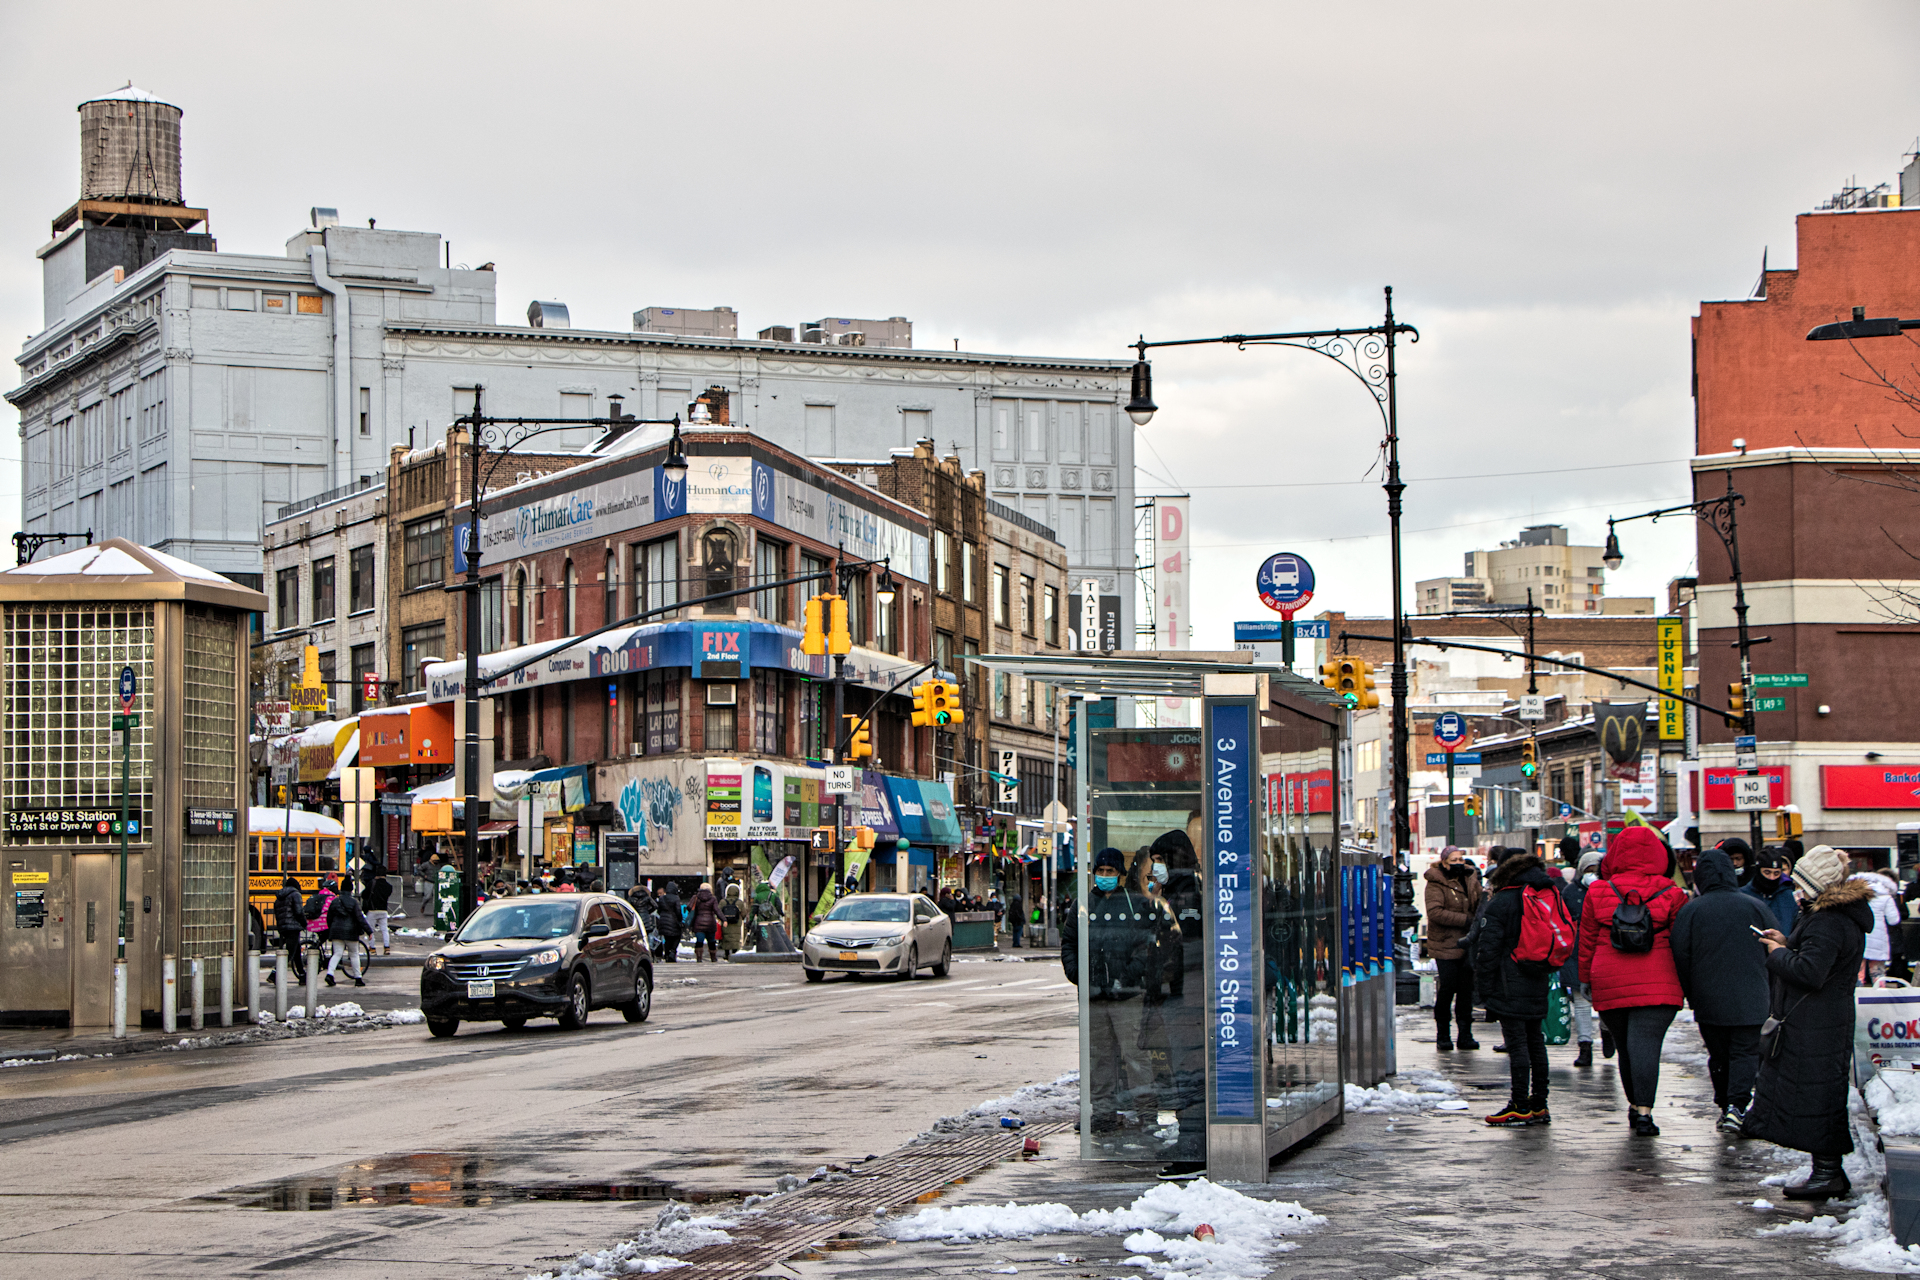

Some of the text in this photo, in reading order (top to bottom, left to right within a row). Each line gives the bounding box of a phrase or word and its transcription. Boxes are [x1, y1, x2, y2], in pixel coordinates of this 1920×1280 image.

[687, 484, 752, 495] HumanCare
[531, 496, 593, 535] HumanCare
[838, 504, 877, 546] HumanCare
[1263, 594, 1310, 611] NO STANDING
[1085, 583, 1098, 650] TATTOO
[1237, 623, 1278, 632] Williamsbridge
[1296, 624, 1326, 638] Bx41
[702, 632, 740, 652] FIX
[706, 652, 740, 660] 2nd Floor
[548, 658, 585, 673] Computer Repair
[368, 678, 376, 698] TAX
[443, 678, 460, 697] Phone
[292, 688, 326, 706] FABRIC
[257, 701, 290, 714] INCOME
[1756, 700, 1761, 710] E
[1763, 699, 1776, 710] 149
[1521, 708, 1544, 716] TURNS
[417, 749, 439, 757] NAILS
[1173, 756, 1180, 765] B
[1427, 754, 1446, 764] Bx41
[833, 770, 845, 778] NO
[1708, 774, 1731, 785] Bank
[1884, 772, 1910, 783] Bank
[1744, 781, 1759, 791] NO
[1526, 796, 1536, 807] NO
[1737, 795, 1768, 804] TURNS
[10, 811, 117, 823] 3 Av-149 St Station
[1522, 813, 1541, 823] TURNS
[10, 823, 21, 831] To
[22, 823, 37, 831] 241
[39, 822, 49, 831] St
[60, 822, 80, 832] Dyre
[81, 822, 92, 830] Av
[100, 823, 107, 832] 2
[114, 822, 121, 831] 5
[1217, 738, 1240, 1048] 3 Avenue & East 149 Street
